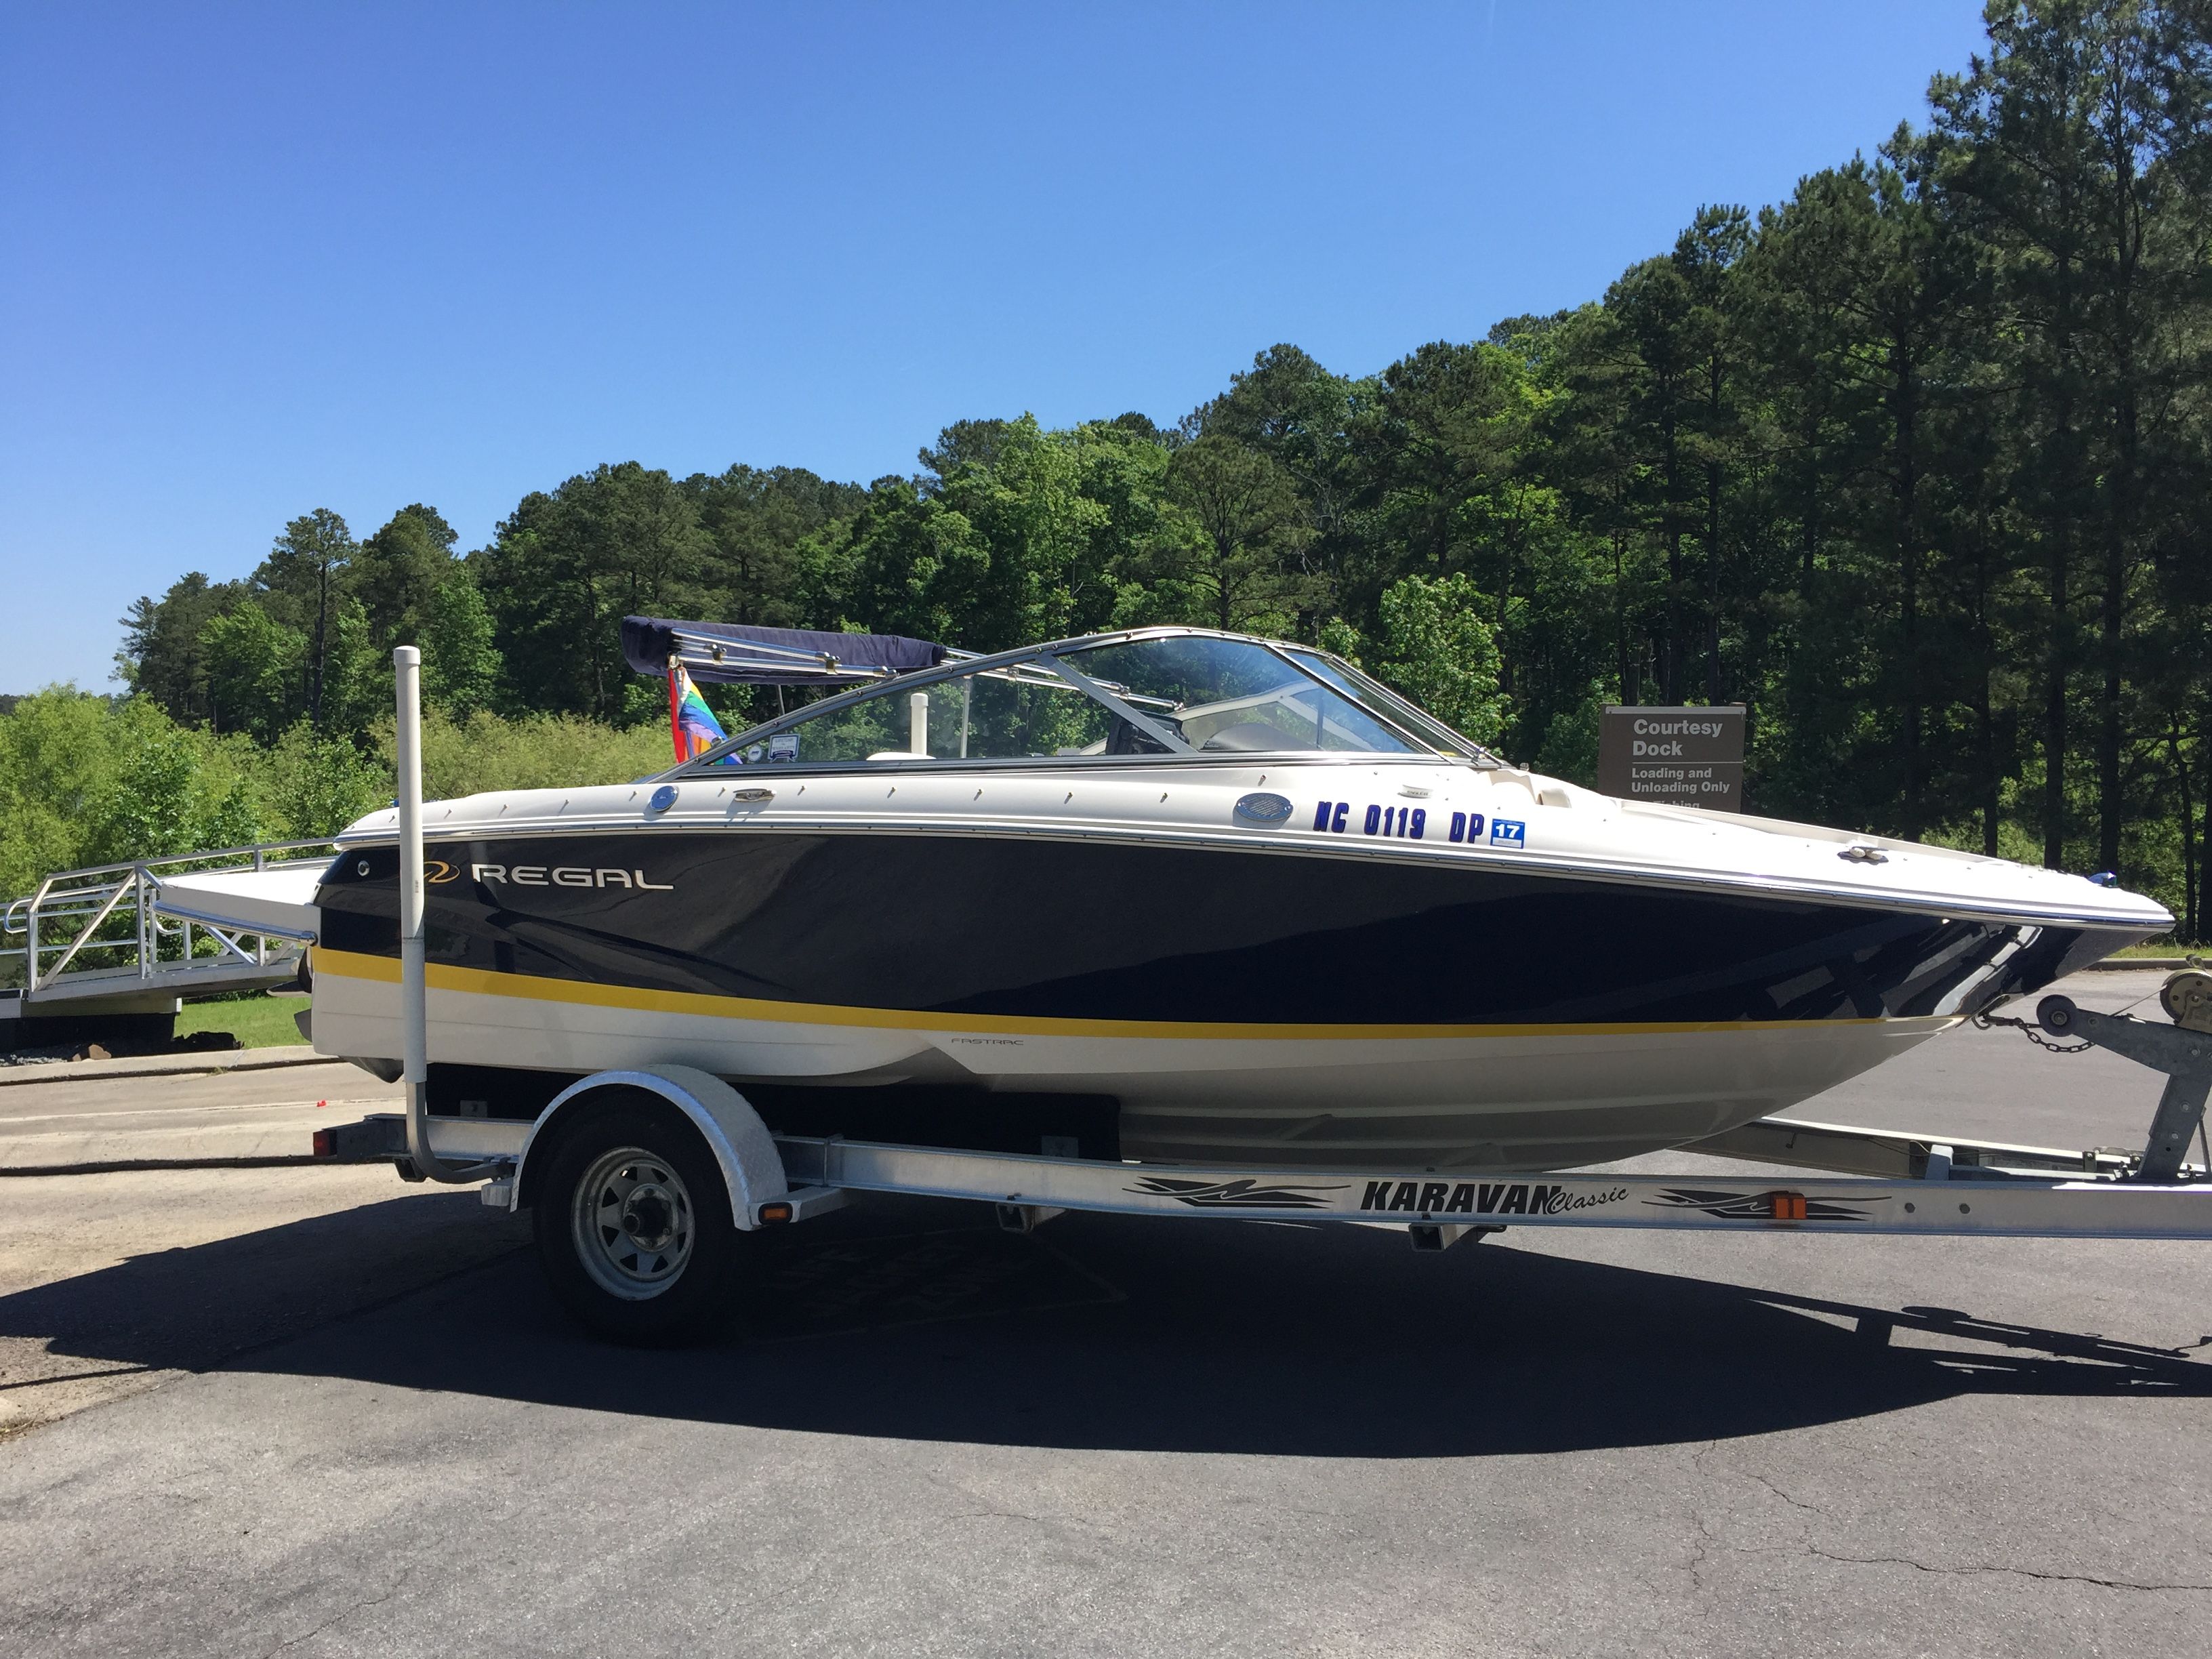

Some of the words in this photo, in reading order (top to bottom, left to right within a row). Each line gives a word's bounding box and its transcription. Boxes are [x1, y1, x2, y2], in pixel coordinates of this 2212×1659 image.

[1633, 719, 1723, 737] Courtesy
[1633, 740, 1683, 756] Dock
[1632, 767, 1684, 779] Loading
[1688, 767, 1712, 778] and
[1631, 781, 1697, 794] Unloading
[1701, 781, 1730, 793] Only
[1653, 800, 1700, 808] hing
[1313, 801, 1349, 833] NC
[1364, 804, 1426, 840] 0119
[1448, 812, 1485, 844] DP
[1495, 823, 1520, 838] 17
[472, 863, 674, 890] REGAL
[951, 1038, 1024, 1046] FASTRAC
[1360, 1181, 1562, 1215] KARAVAN
[1547, 1187, 1629, 1214] Classic
